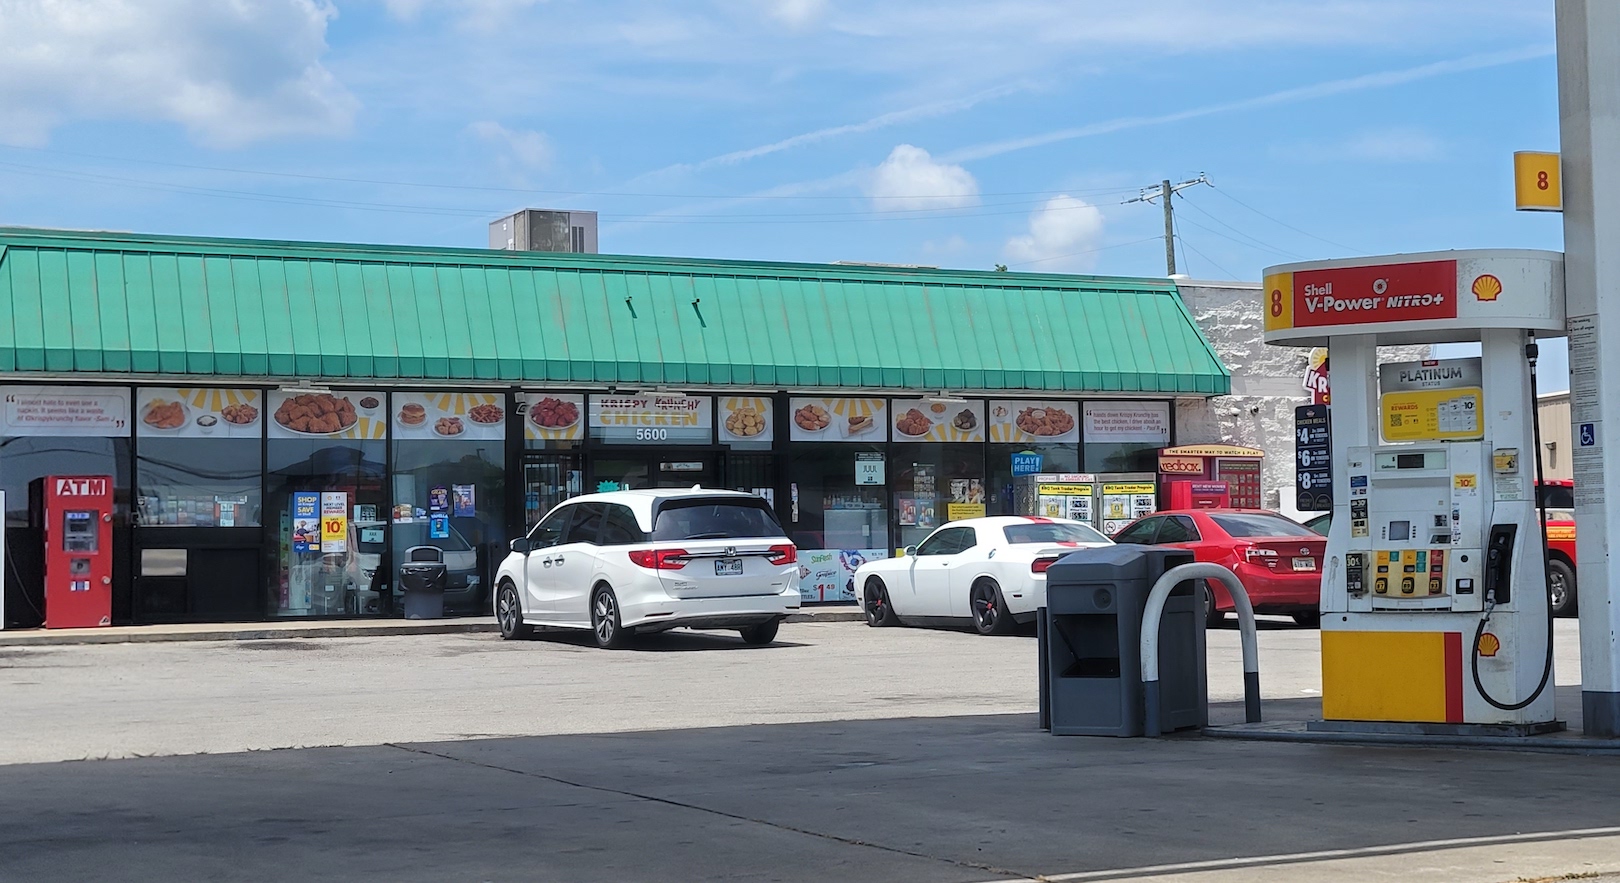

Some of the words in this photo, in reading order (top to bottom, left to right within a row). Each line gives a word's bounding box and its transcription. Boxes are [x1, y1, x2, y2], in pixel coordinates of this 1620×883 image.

[1537, 170, 1549, 191] 8
[1304, 282, 1333, 297] Shell
[1271, 289, 1283, 318] 8
[1305, 295, 1381, 313] V-Power
[1386, 293, 1445, 309] NITRO+
[1307, 370, 1329, 393] KR
[1400, 367, 1463, 382] PLATINUM
[600, 399, 648, 408] KRISPY
[655, 397, 701, 410] KRUNCHY
[600, 410, 699, 426] CHICKEN
[636, 428, 668, 441] 5600
[1297, 428, 1309, 444] $4
[1298, 450, 1311, 467] $6
[1014, 463, 1040, 472] HERE!
[60, 479, 104, 496] ATM
[1298, 472, 1312, 490] $8
